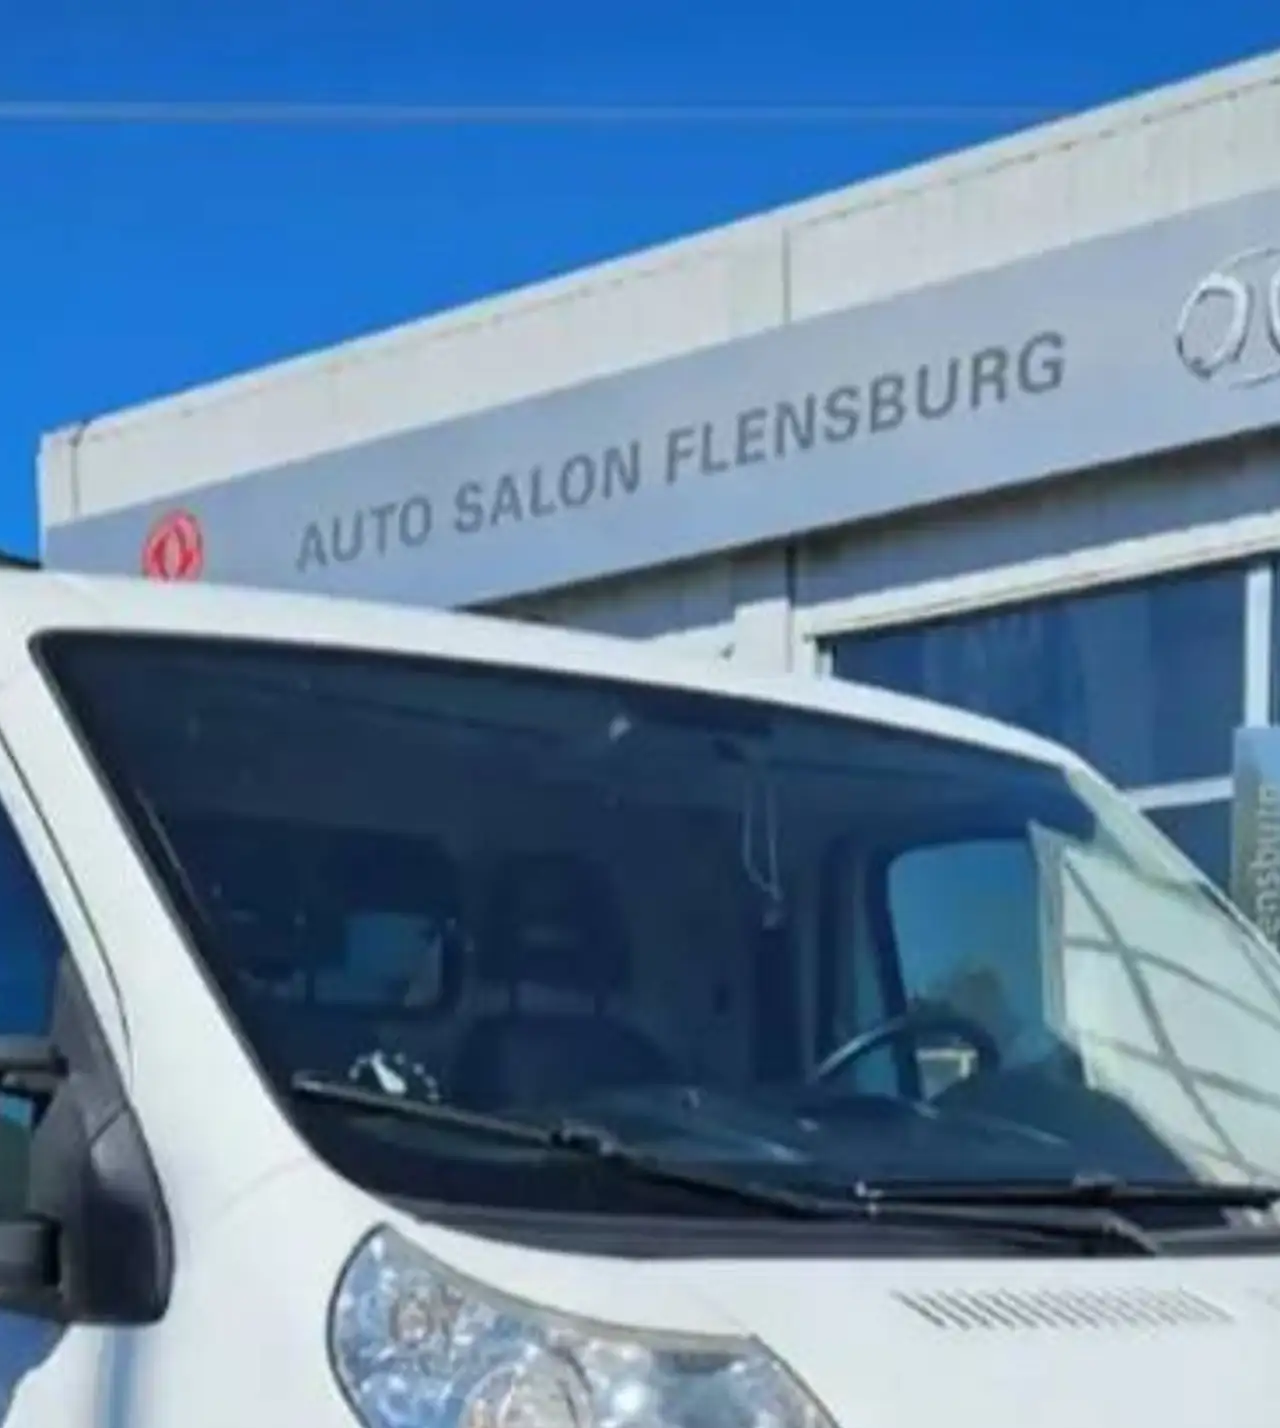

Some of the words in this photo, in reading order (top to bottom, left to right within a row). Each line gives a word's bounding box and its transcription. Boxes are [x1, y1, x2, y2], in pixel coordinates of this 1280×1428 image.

[295, 492, 433, 573] AUTO
[453, 440, 642, 536] SALON
[665, 330, 1066, 487] FLENSBURG
